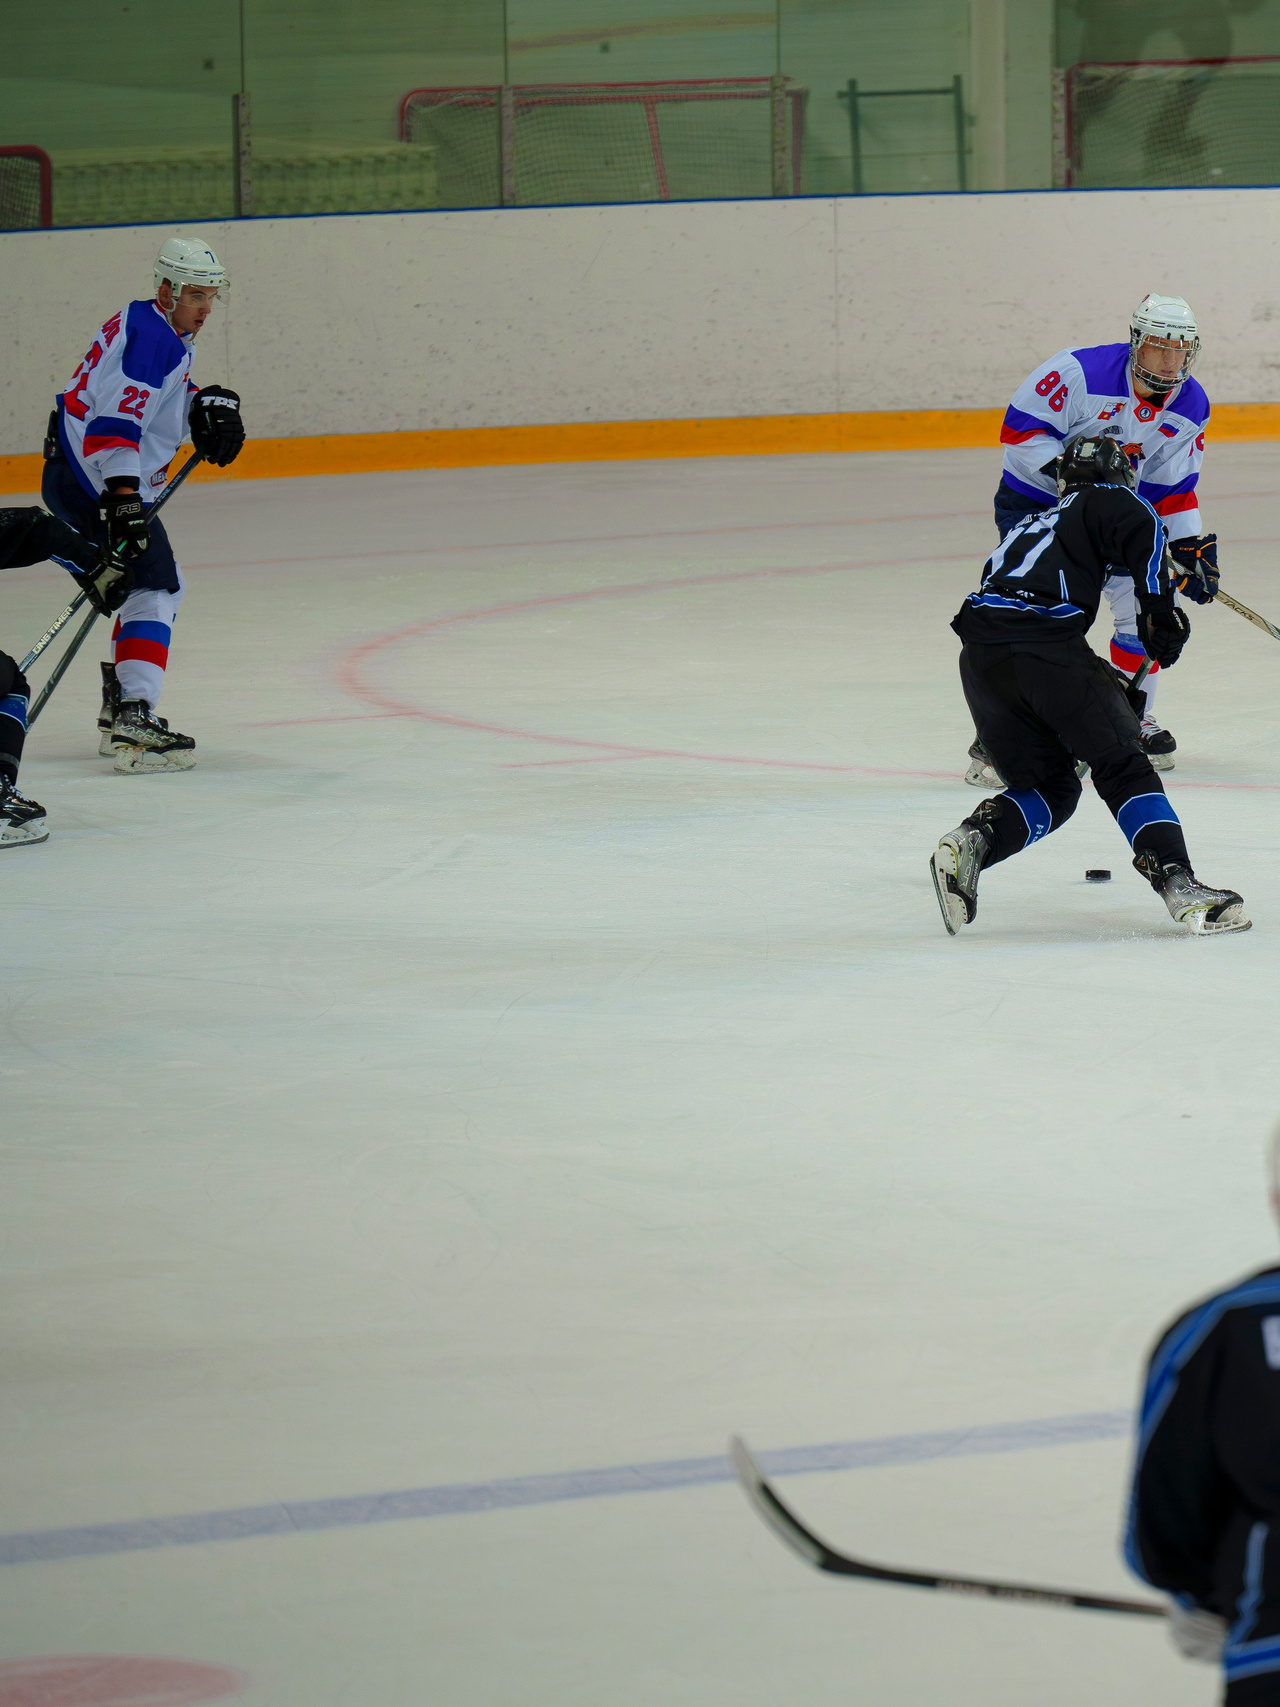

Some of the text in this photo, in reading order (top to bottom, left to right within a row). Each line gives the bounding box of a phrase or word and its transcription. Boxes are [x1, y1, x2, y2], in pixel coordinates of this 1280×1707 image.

[117, 385, 150, 420] 22
[200, 395, 239, 410] TPS
[1034, 370, 1069, 413] 86
[47, 605, 74, 635] TIMER
